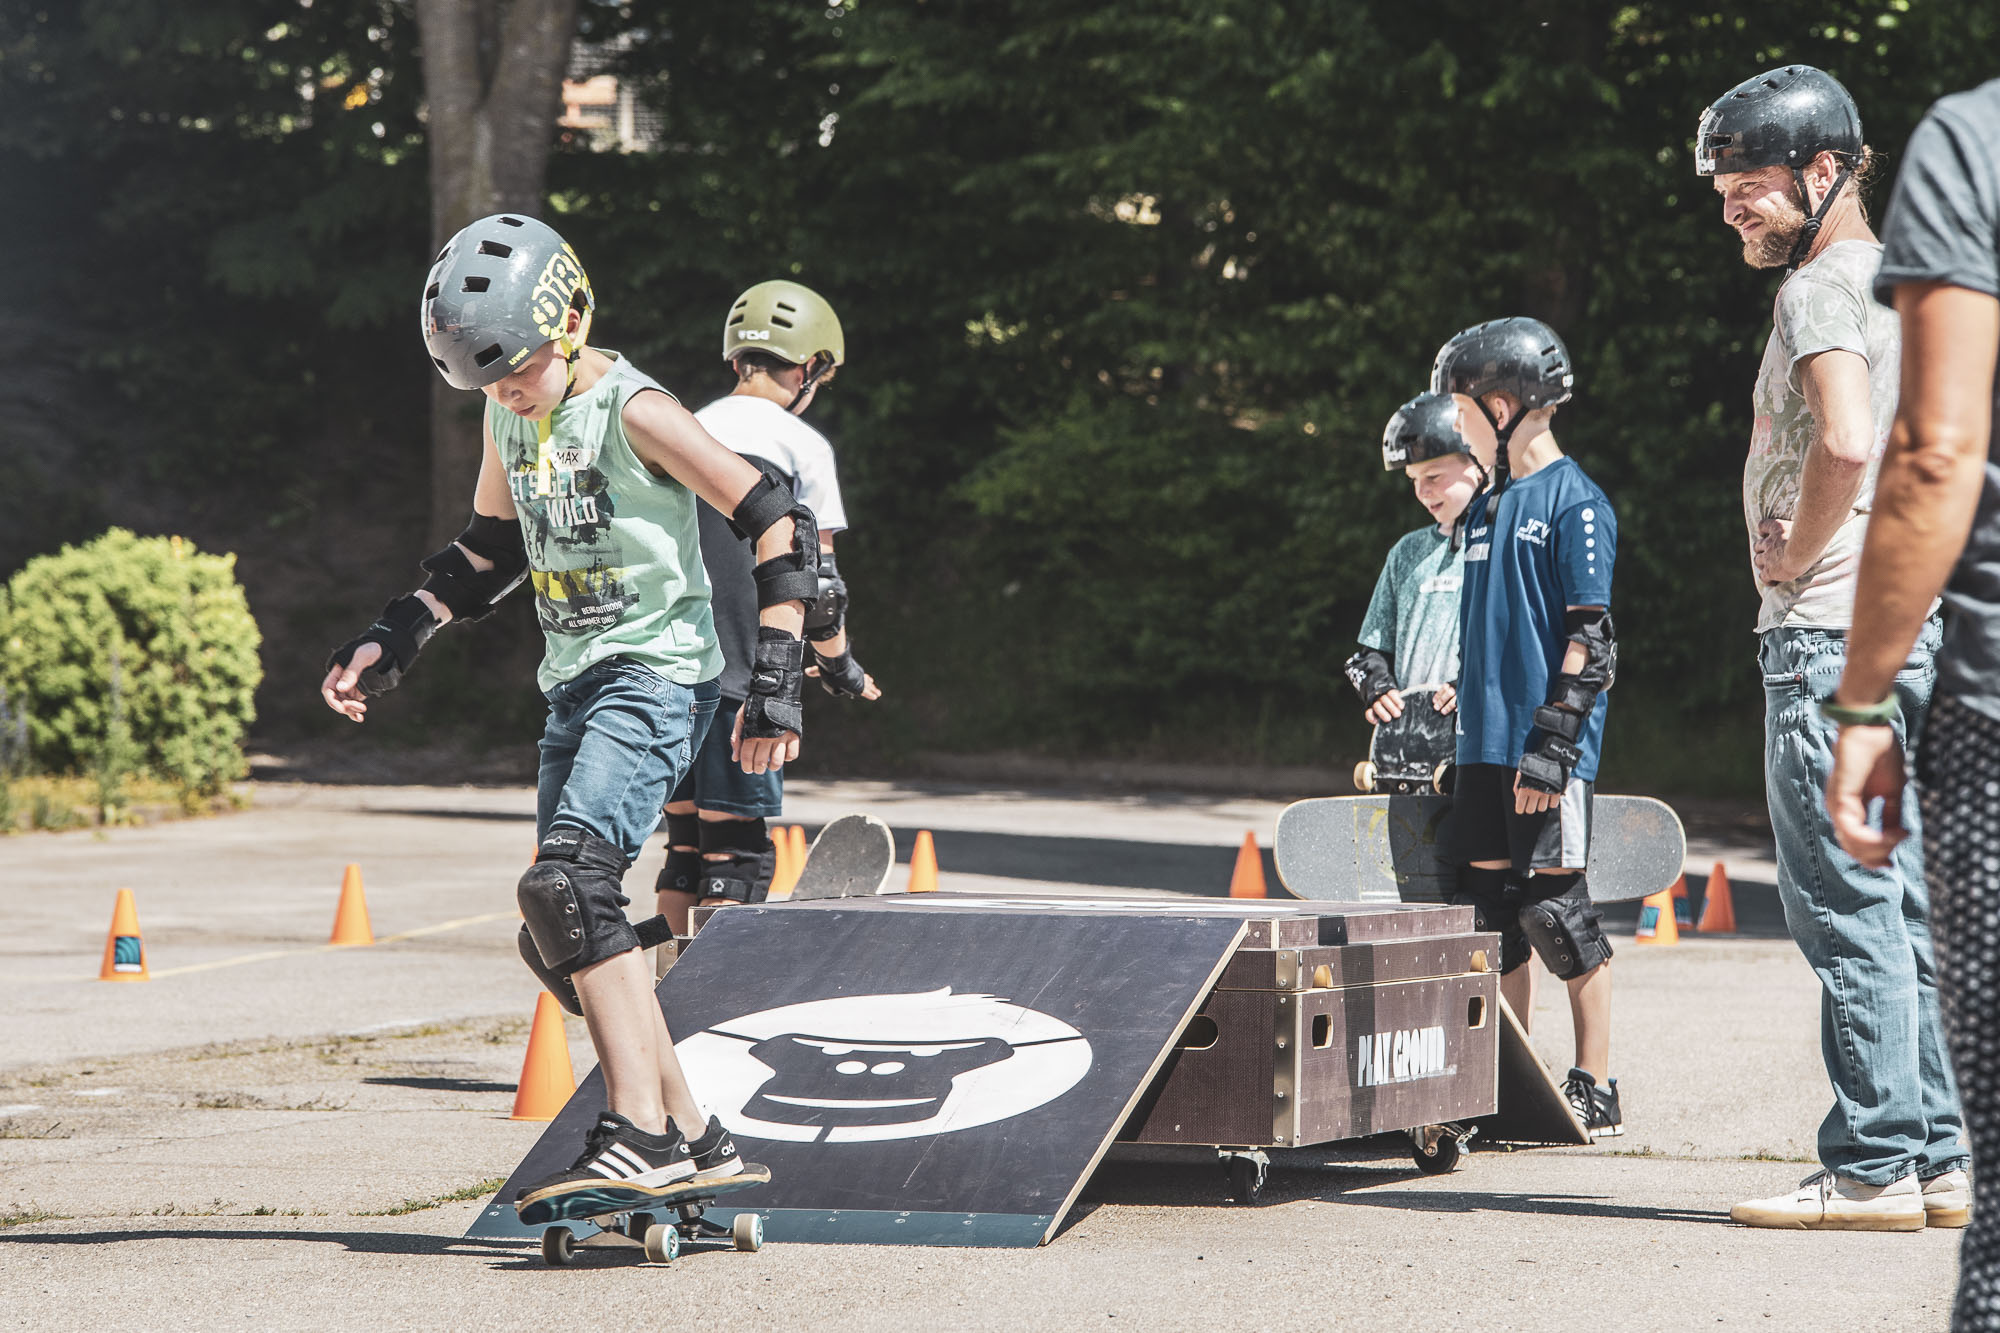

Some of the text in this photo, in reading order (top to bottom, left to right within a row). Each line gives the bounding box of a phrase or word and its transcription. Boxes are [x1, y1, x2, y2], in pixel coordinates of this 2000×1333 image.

[556, 451, 579, 465] MAX
[510, 465, 541, 502] ET'S
[544, 496, 599, 528] WILD
[1357, 1025, 1446, 1088] PLAY GROUND
